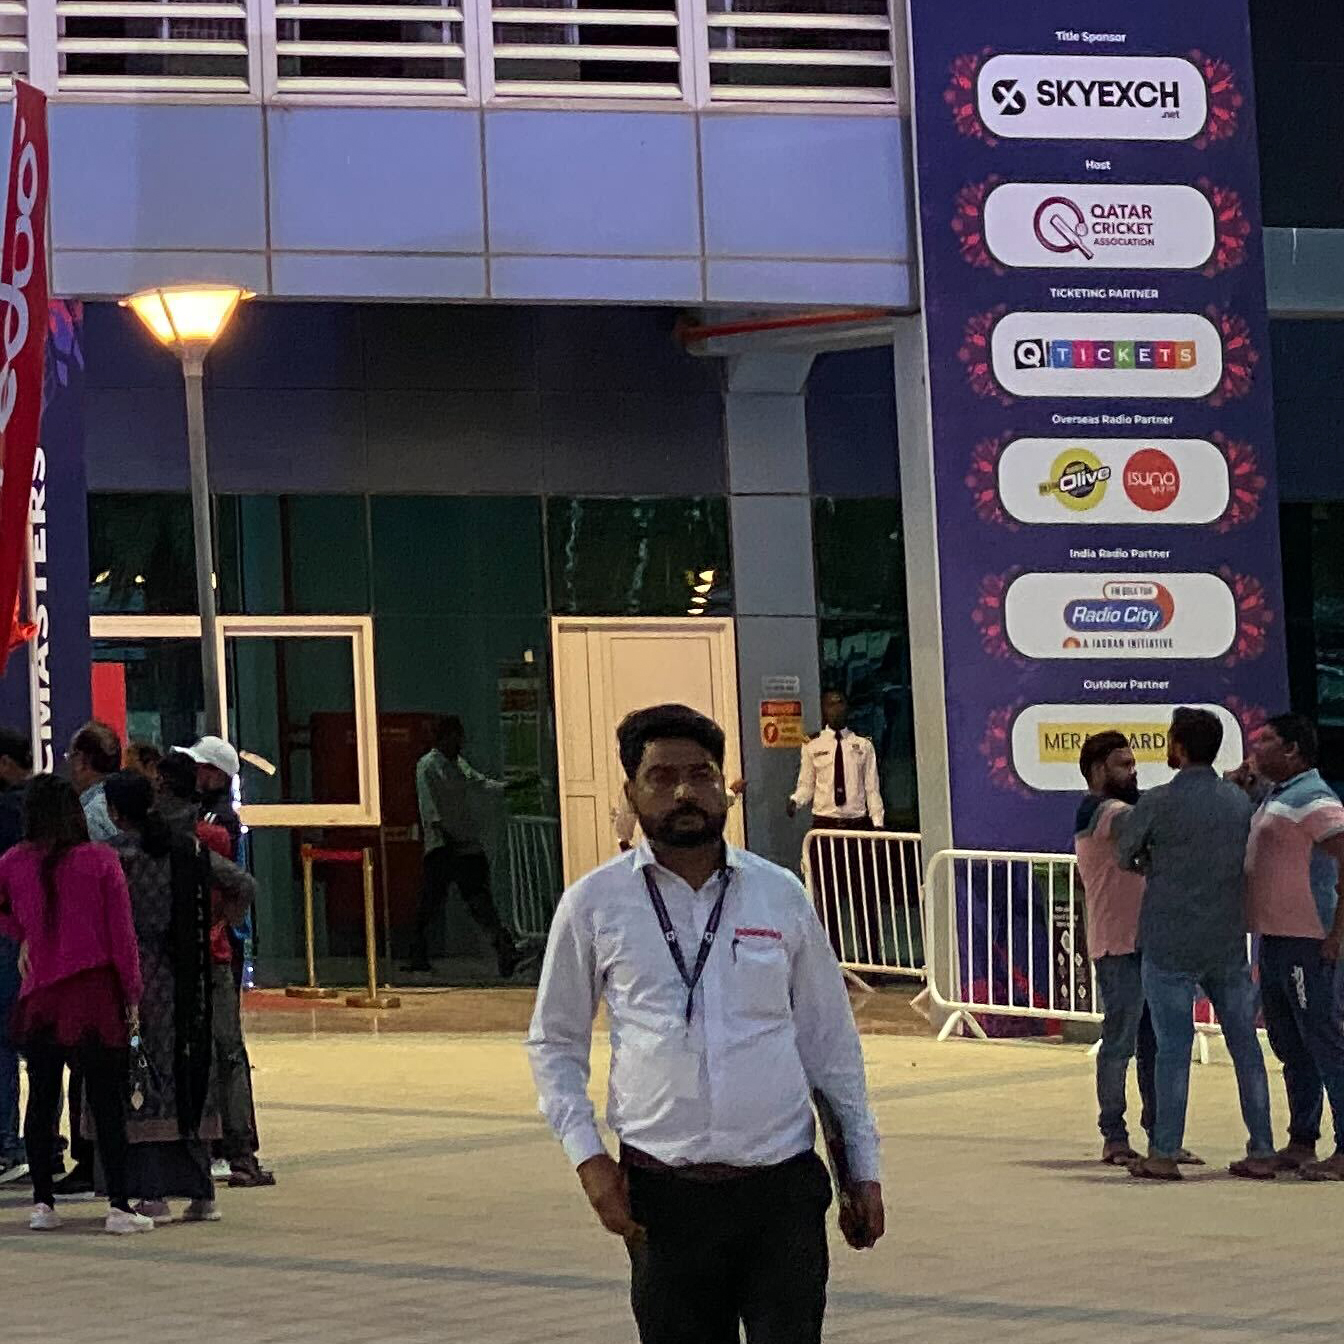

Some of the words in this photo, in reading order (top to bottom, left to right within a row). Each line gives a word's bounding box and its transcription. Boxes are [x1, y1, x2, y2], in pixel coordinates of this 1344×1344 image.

[1054, 30, 1080, 42] Title
[1081, 31, 1127, 44] Sponsor
[1036, 79, 1181, 108] SKYEXCH
[1084, 159, 1112, 171] Host
[1090, 203, 1153, 220] QATAR
[1091, 222, 1154, 235] CRICKET
[1093, 237, 1155, 247] ASSOCIATION
[1049, 288, 1107, 299] TICKETING
[1108, 288, 1159, 300] PARTNER
[1051, 413, 1100, 425] Overseas
[1102, 414, 1133, 425] Radio
[1134, 414, 1174, 426] Partner
[1069, 548, 1097, 560] India
[1098, 548, 1130, 560] Radio
[1131, 548, 1171, 560] Partner
[1072, 606, 1121, 625] Radio
[1124, 606, 1160, 631] City
[1083, 679, 1128, 690] Outdoor
[1129, 679, 1171, 691] Partner
[1044, 732, 1093, 750] MER
